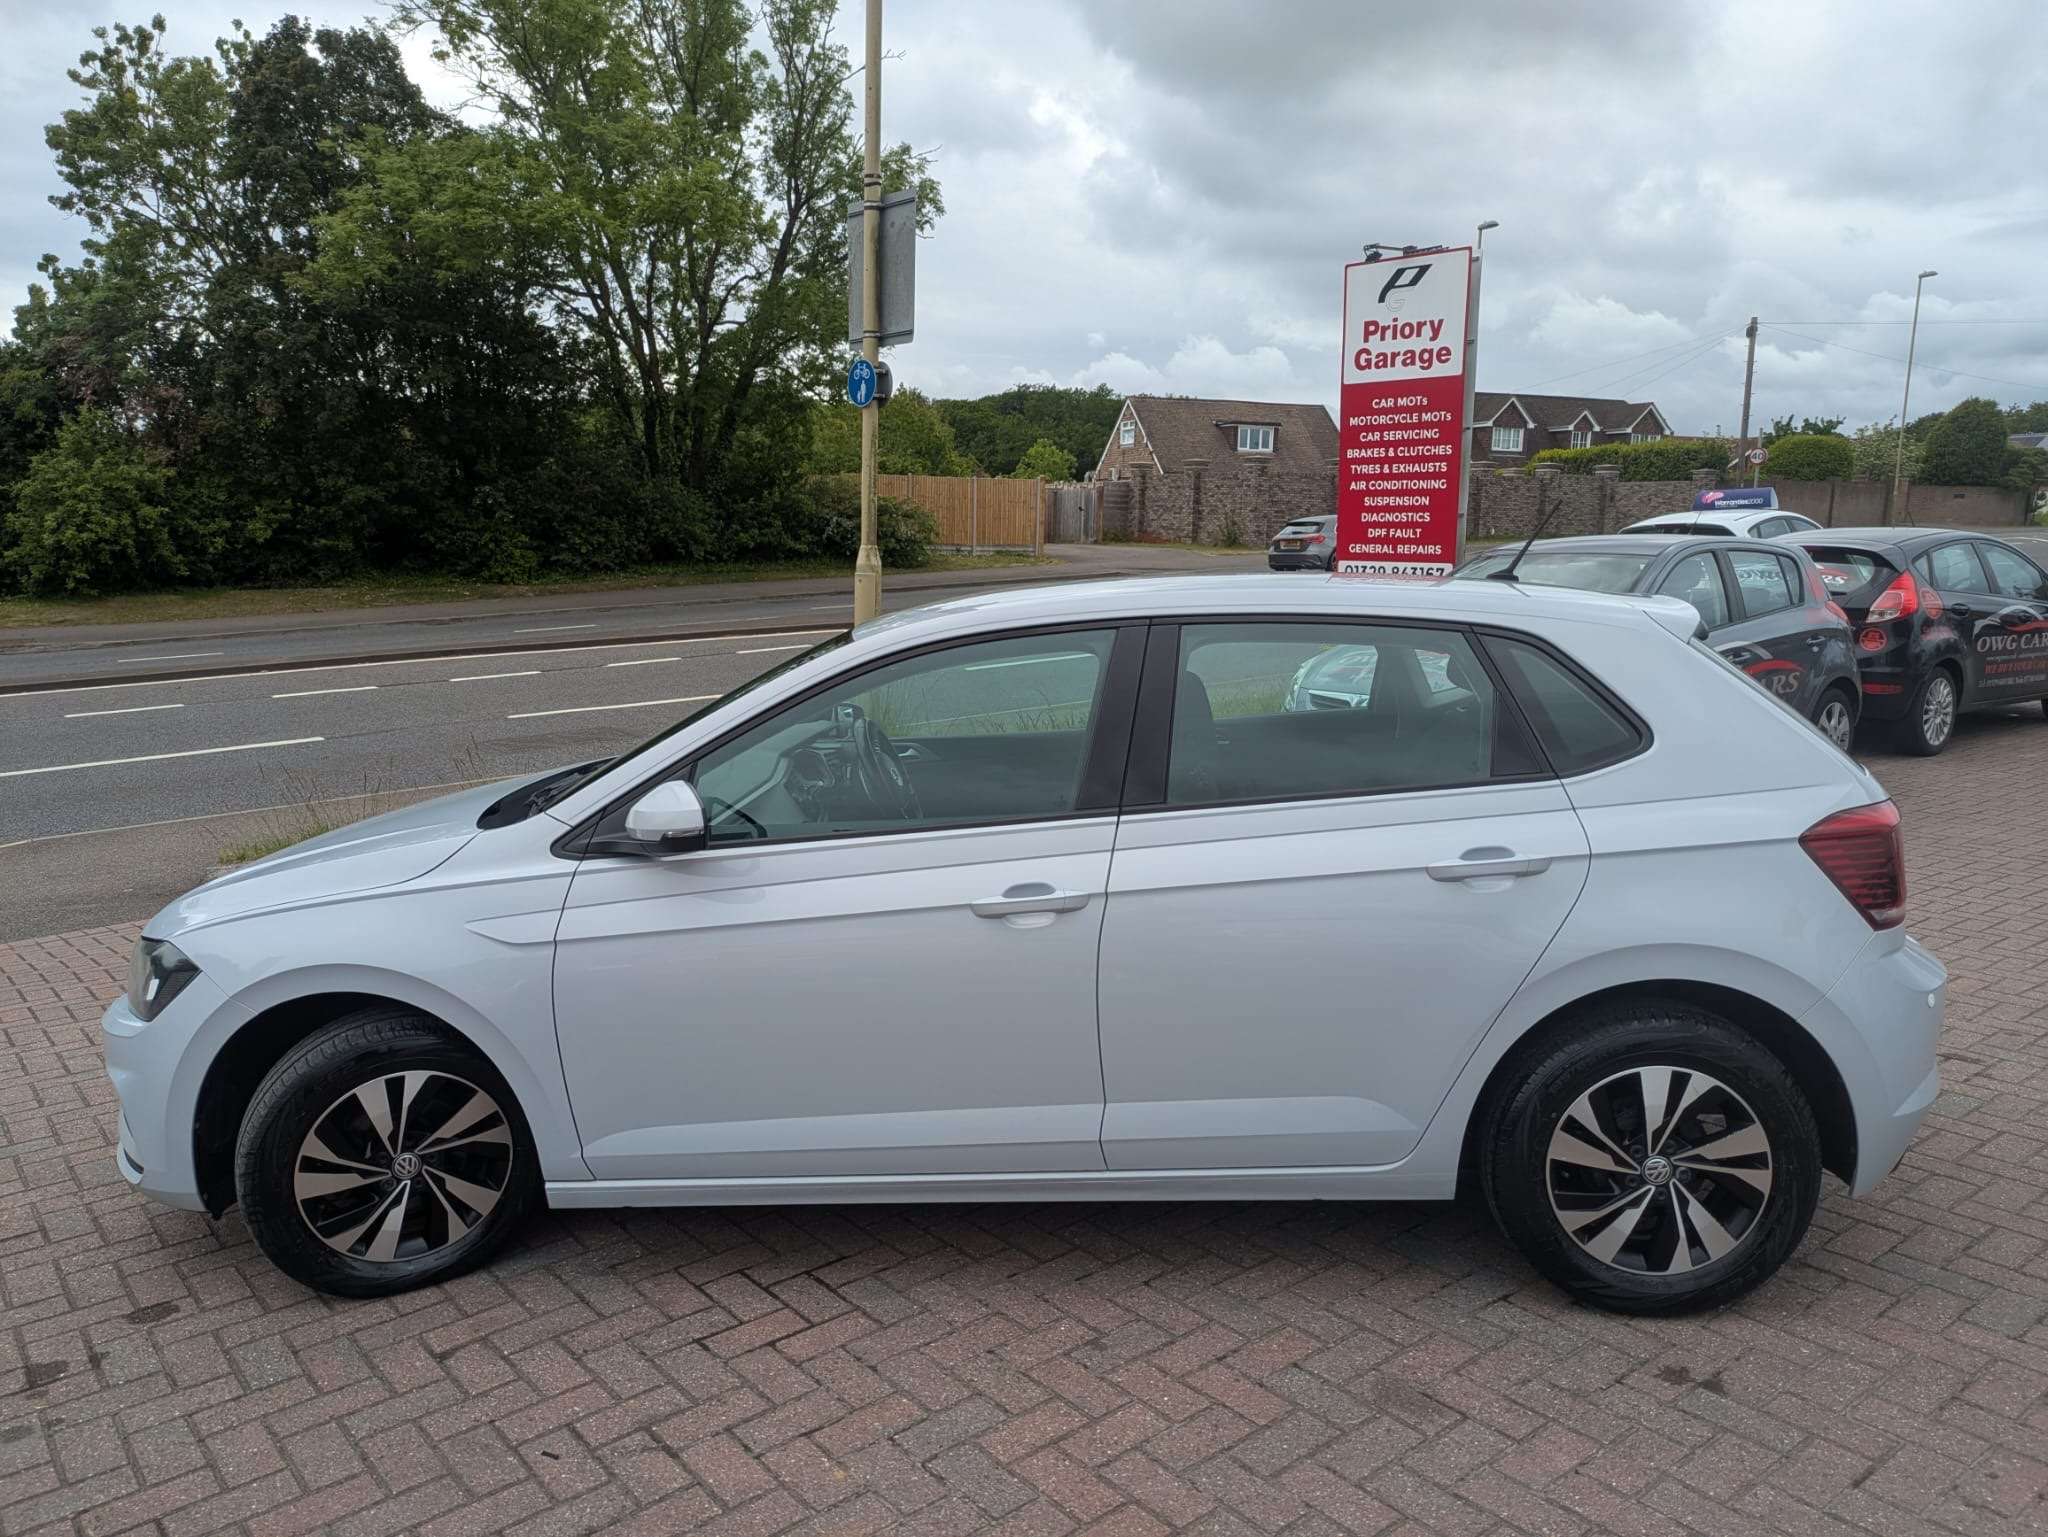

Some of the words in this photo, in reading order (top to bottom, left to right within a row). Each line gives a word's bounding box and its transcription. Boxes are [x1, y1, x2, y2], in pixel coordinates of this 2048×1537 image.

[1363, 317, 1444, 343] Priory
[1354, 346, 1452, 371] Garage
[1372, 398, 1395, 409] CAR
[1397, 395, 1428, 406] MOTs
[1349, 413, 1419, 427] MOTORCYCLE
[1421, 411, 1452, 422] MOTs
[1359, 431, 1381, 442] CAR
[1383, 428, 1440, 440] SERVICING
[1346, 447, 1386, 459] BRAKES
[1387, 447, 1395, 457] &
[1397, 445, 1453, 457] CLUTCHES
[1752, 452, 1764, 460] 40
[1350, 464, 1381, 475] TYRES
[1382, 463, 1390, 474] &
[1392, 462, 1448, 473] EXHAUSTS
[1349, 480, 1367, 491] AIR
[1368, 479, 1447, 490] CONDITIONING
[1364, 495, 1430, 506] SUSPENSION
[1361, 512, 1431, 523] DIAGNOSTICS
[1367, 528, 1388, 538] DPF
[1389, 528, 1422, 539] FAULT
[1348, 543, 1395, 554] GENERAL
[1396, 545, 1442, 555] REPAIRS
[1977, 634, 2017, 652] OWG
